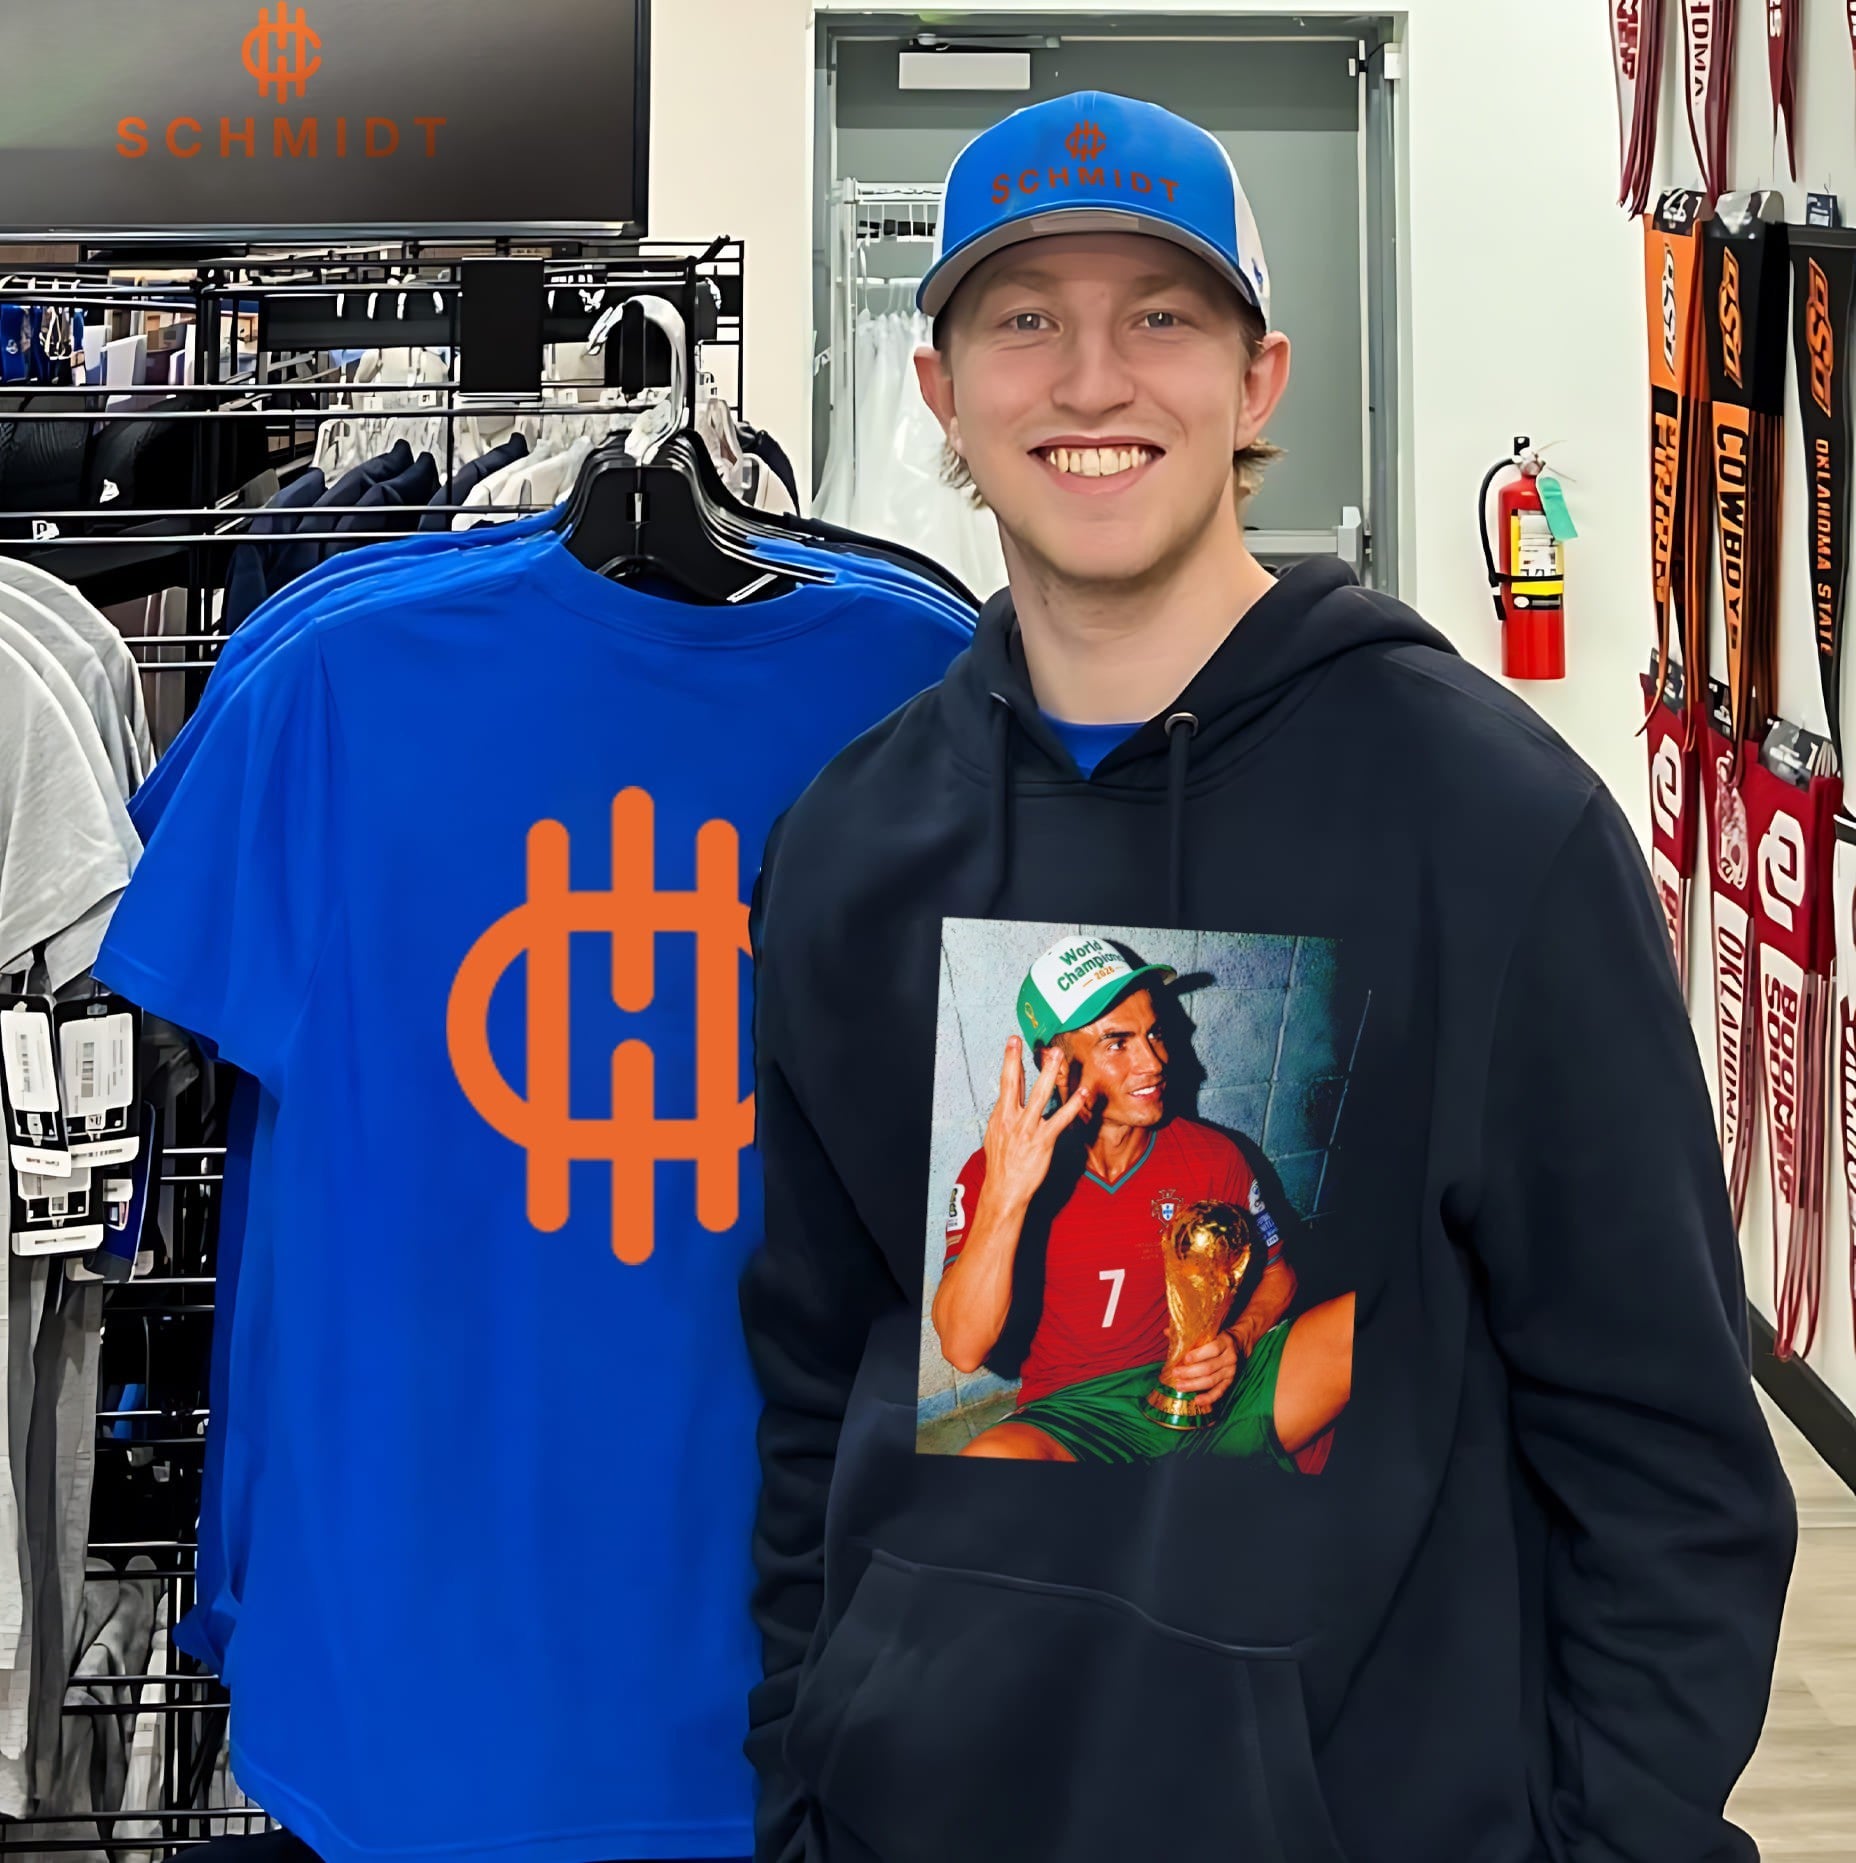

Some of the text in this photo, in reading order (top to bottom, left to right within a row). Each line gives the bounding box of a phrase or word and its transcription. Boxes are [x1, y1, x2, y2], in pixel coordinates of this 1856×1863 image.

[115, 116, 448, 158] SCHMIDT
[991, 167, 1180, 205] SCHMIDT
[1717, 423, 1748, 649] COWBOY
[1816, 438, 1834, 656] OKLAHOMA STATE
[1059, 940, 1103, 966] World
[1094, 965, 1115, 980] 2026
[1099, 1268, 1126, 1328] 7
